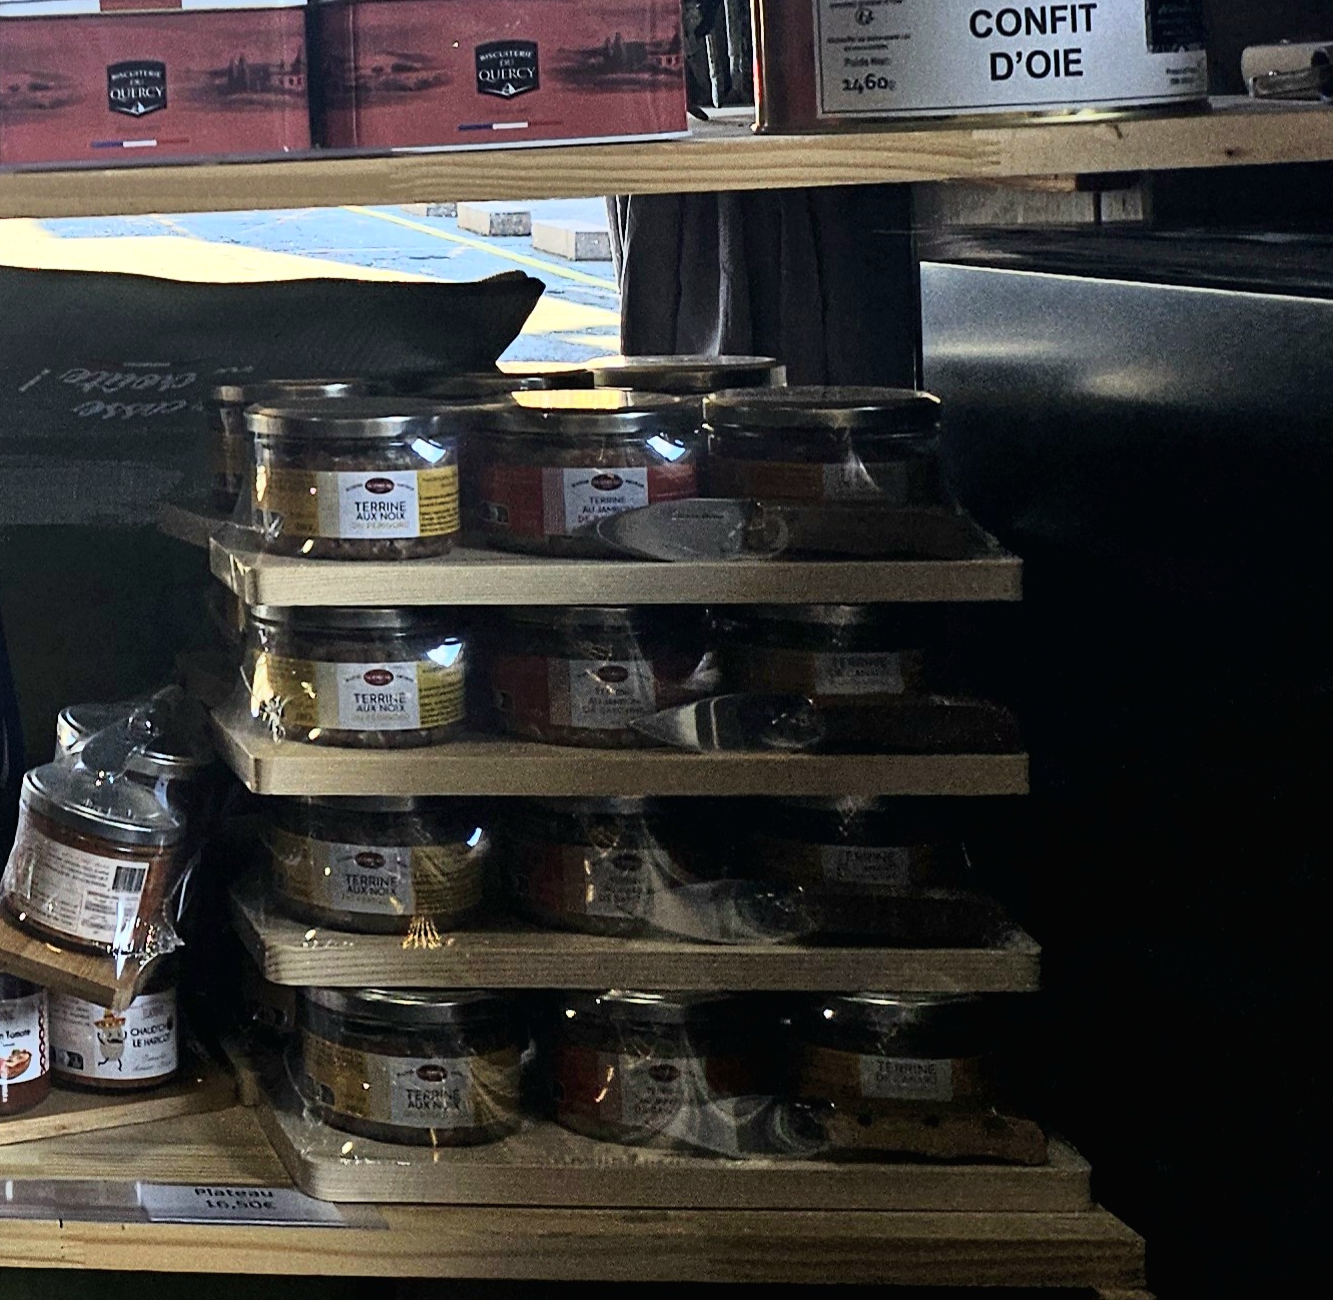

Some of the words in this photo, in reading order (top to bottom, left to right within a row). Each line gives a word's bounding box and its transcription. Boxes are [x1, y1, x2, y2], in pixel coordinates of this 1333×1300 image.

[969, 3, 1097, 38] CONFIT
[479, 66, 536, 83] QUERCY
[109, 83, 164, 100] QUERCY
[355, 501, 407, 513] TERRINE
[356, 511, 376, 520] AUX
[380, 511, 405, 521] NOIX
[5, 1027, 31, 1039] Tomate
[195, 1186, 275, 1200] Plateau
